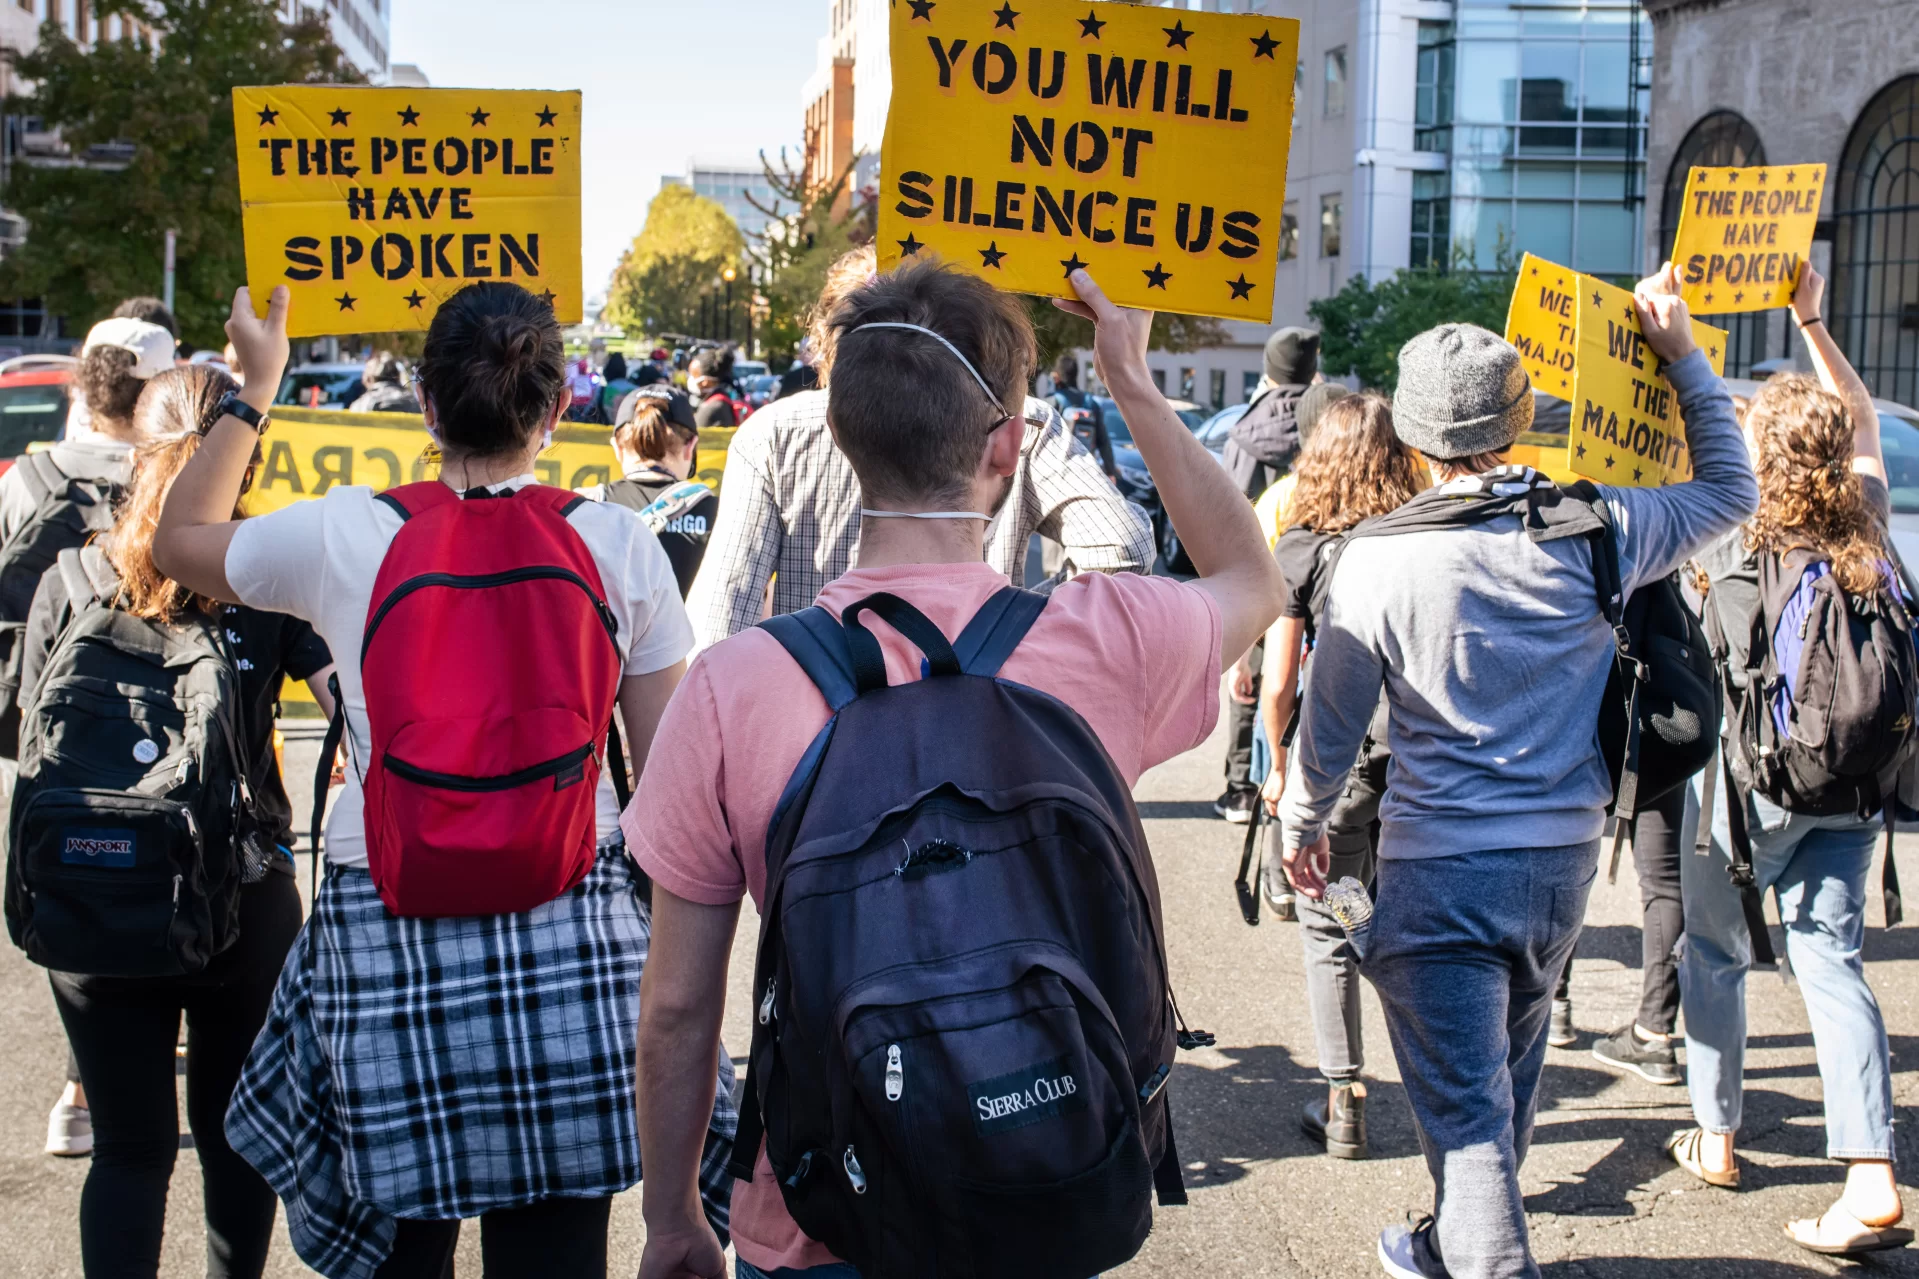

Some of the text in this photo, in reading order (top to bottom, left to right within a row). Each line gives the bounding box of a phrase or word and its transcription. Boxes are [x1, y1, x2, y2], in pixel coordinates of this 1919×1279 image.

[927, 36, 1249, 122] YOU WILL
[259, 136, 554, 178] THE PEOPLE
[1010, 114, 1153, 178] NOT
[347, 186, 474, 220] HAVE
[895, 170, 1262, 259] SILENCE US
[1694, 188, 1816, 216] THE PEOPLE
[1723, 223, 1778, 245] HAVE
[284, 232, 539, 281] SPOKEN
[1684, 252, 1798, 284] SPOKEN
[1539, 286, 1573, 319] WE
[1608, 320, 1647, 371] WE
[1632, 378, 1669, 421] THE
[65, 837, 131, 856] JANSPORT
[977, 1075, 1076, 1121] SIERRA CLUB
